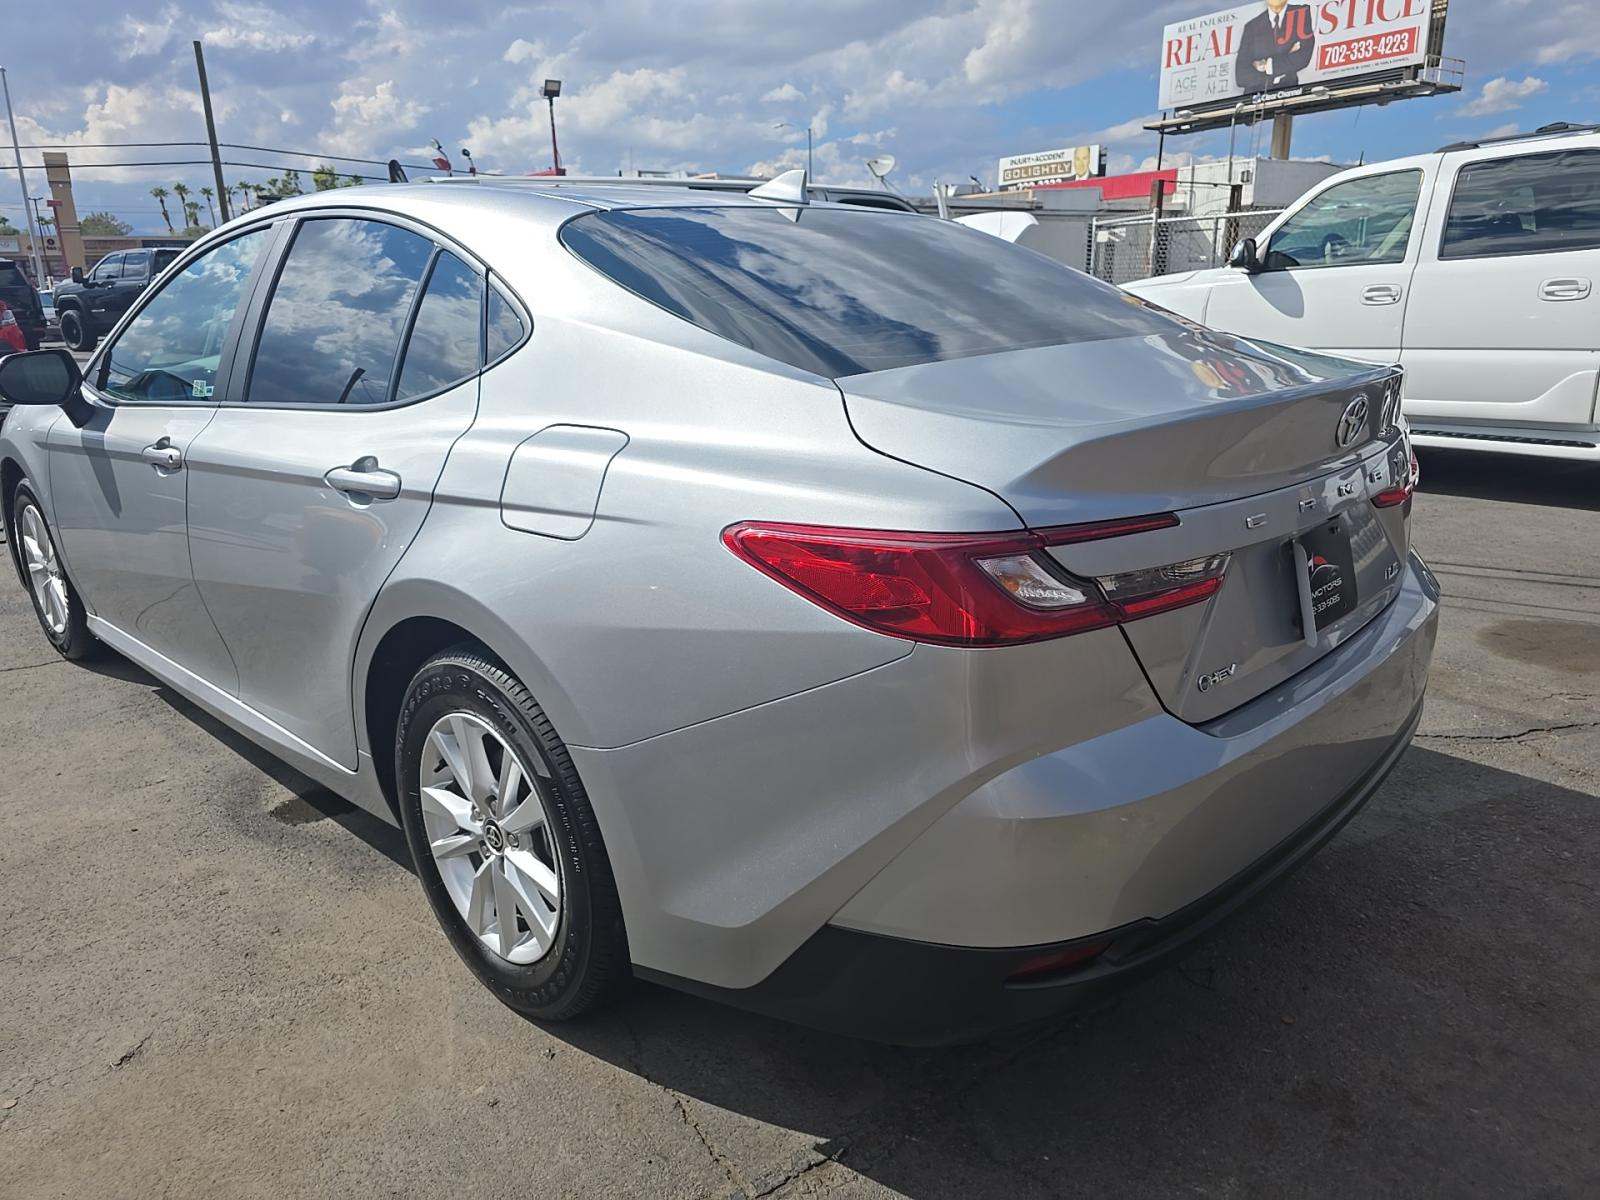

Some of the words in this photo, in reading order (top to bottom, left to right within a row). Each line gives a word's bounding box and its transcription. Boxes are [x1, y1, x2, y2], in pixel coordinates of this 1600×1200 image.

[1165, 25, 1237, 68] REAL
[1277, 0, 1425, 45] JUSTICE
[1324, 32, 1409, 66] 702-333-4223
[1175, 75, 1198, 91] ACE
[1004, 161, 1070, 180] GOLIGHTLY
